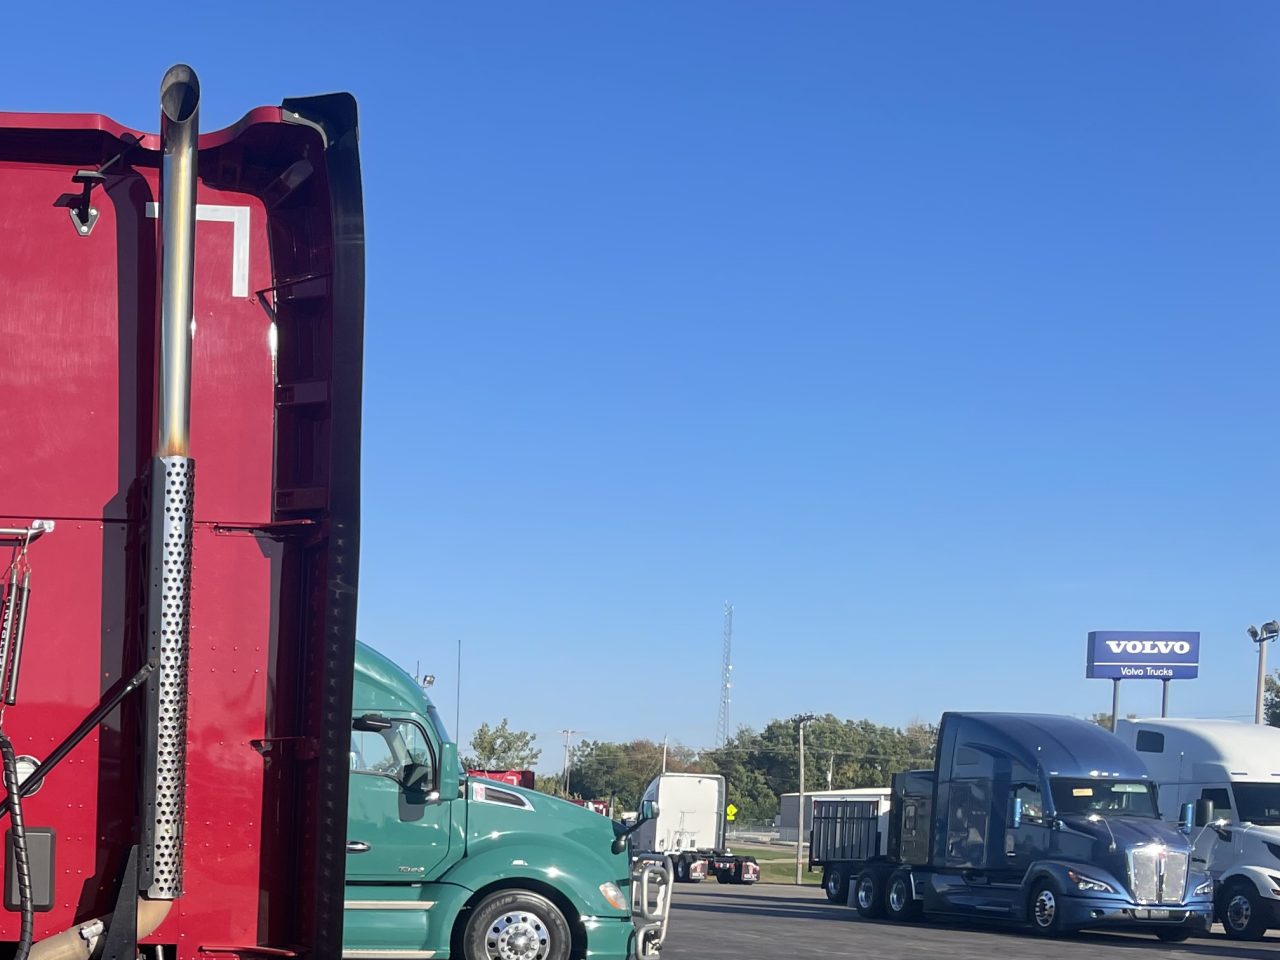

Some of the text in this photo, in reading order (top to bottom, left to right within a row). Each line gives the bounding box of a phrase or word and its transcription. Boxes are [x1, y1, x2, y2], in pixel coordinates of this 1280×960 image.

[1105, 640, 1190, 654] VOLVO
[1120, 667, 1173, 676] Volvo Trucks
